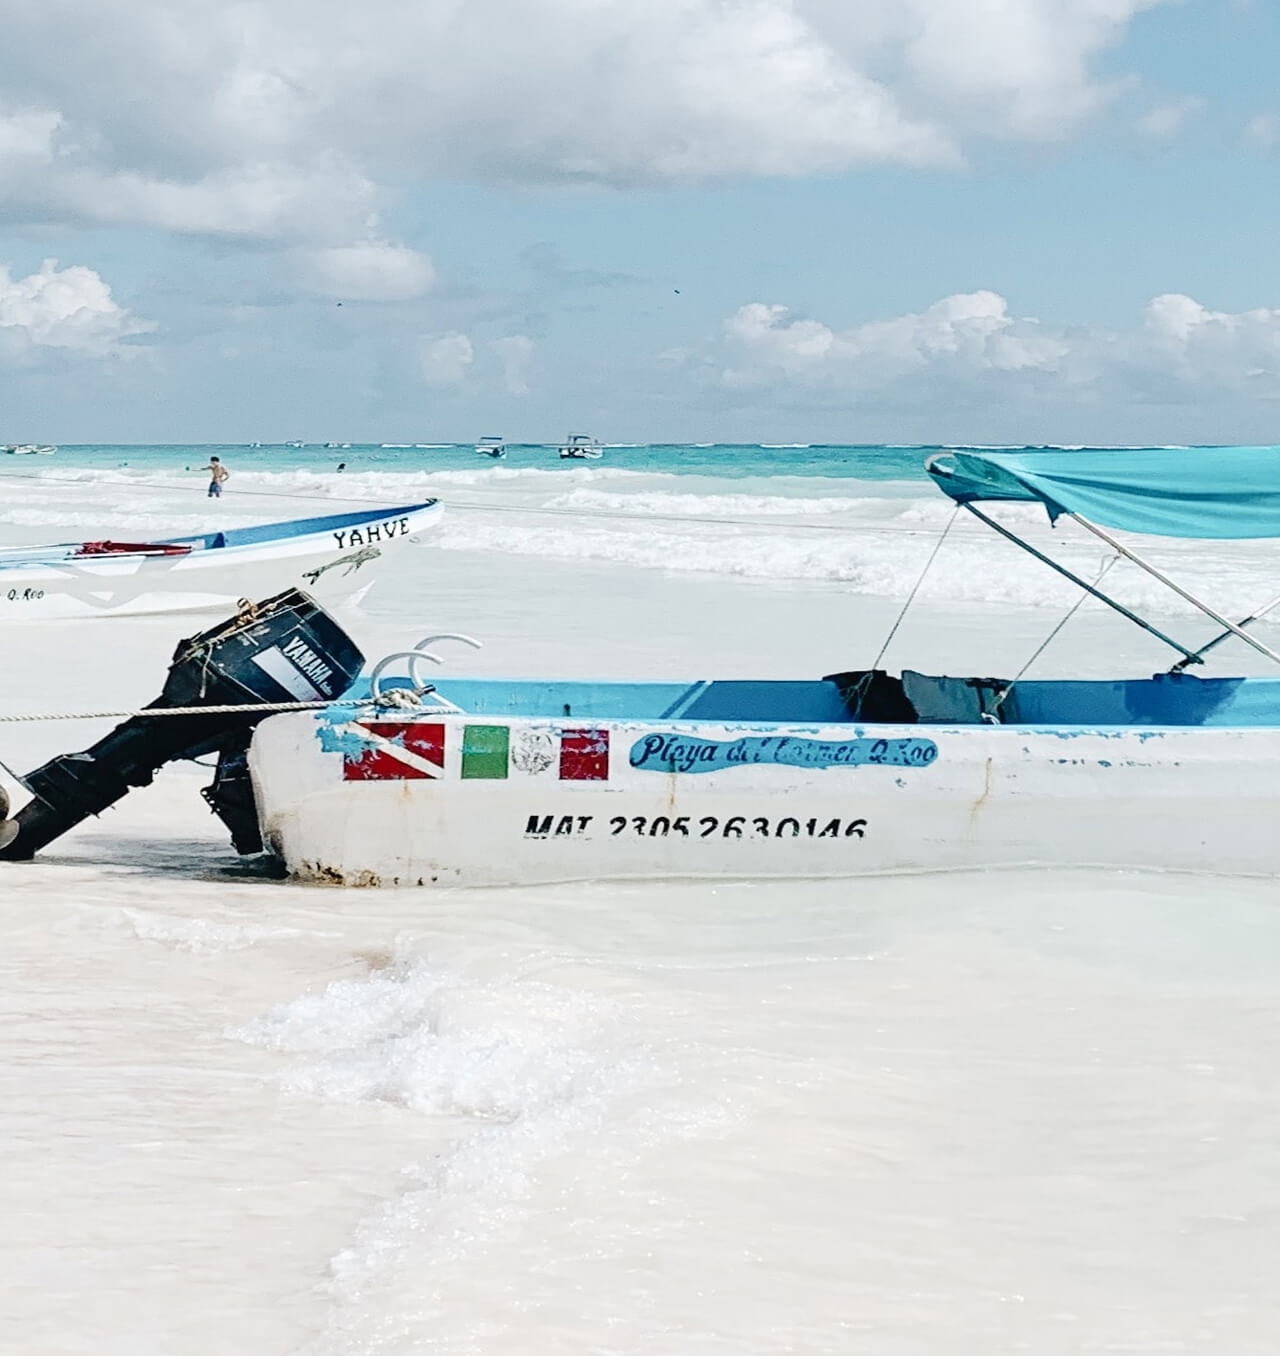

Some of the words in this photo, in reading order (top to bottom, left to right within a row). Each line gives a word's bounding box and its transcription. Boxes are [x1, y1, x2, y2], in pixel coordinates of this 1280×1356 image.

[333, 517, 410, 549] YAHVE
[282, 635, 334, 685] YAMAHA
[629, 735, 719, 772] Playa
[523, 815, 593, 839] MAT
